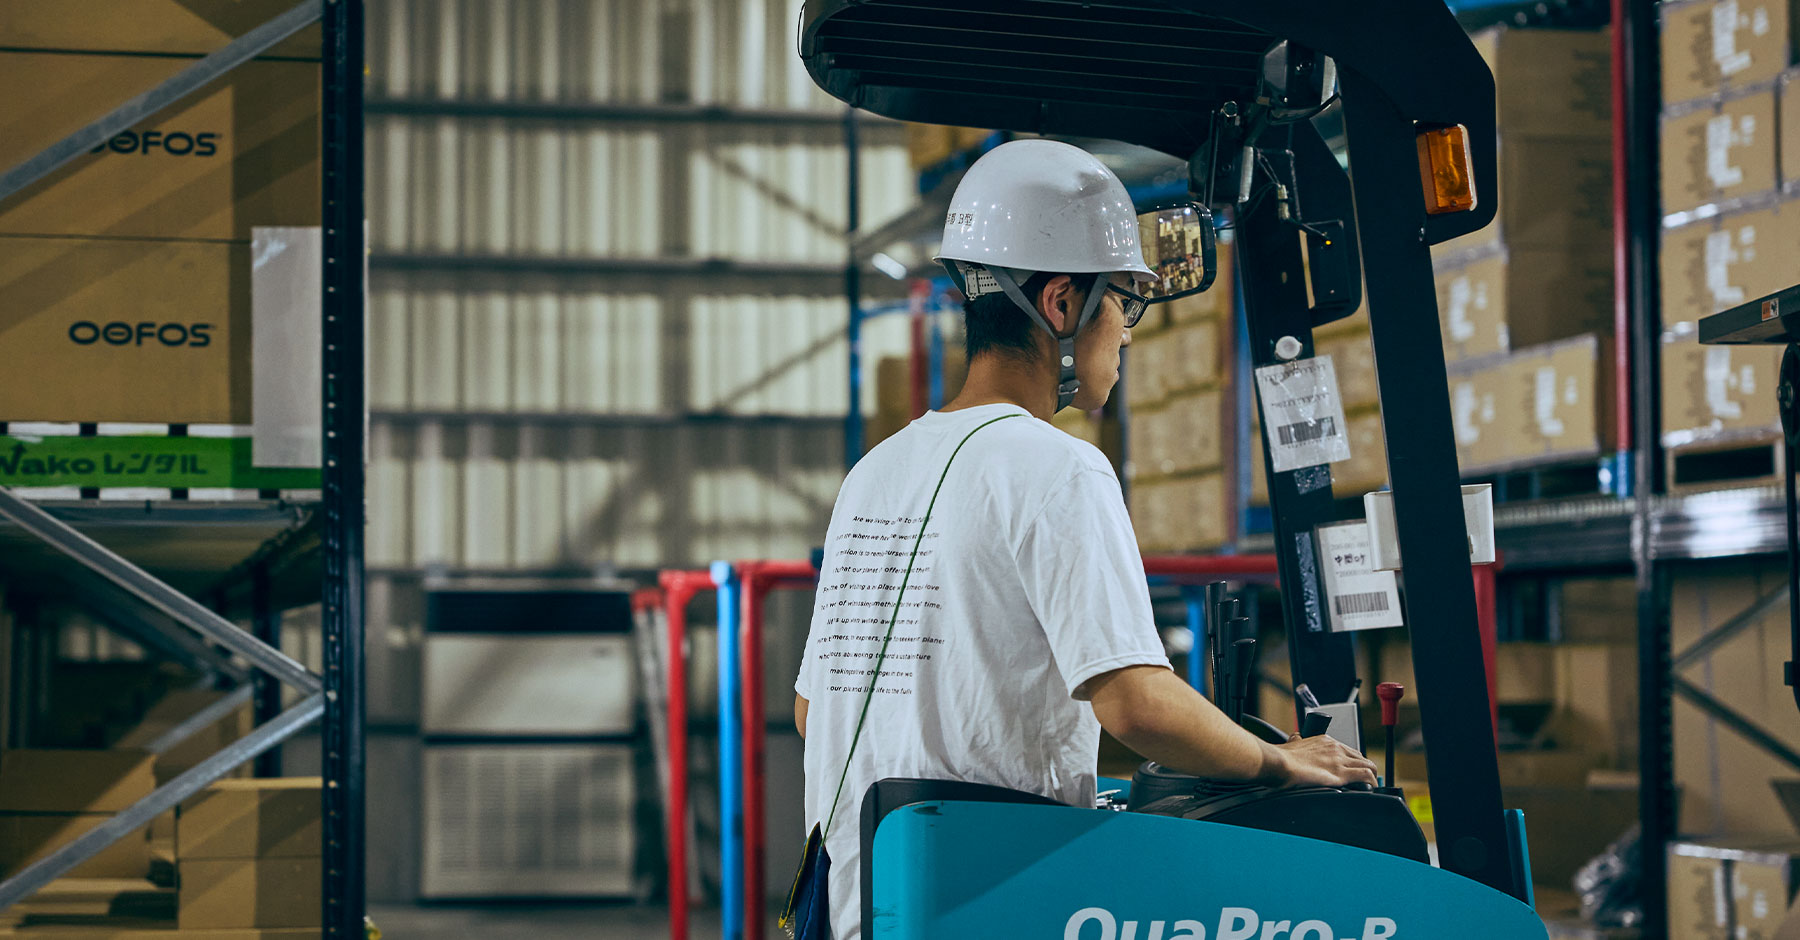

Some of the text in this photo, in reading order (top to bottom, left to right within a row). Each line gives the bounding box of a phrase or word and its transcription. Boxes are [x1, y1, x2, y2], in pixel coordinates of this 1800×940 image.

[88, 130, 217, 156] OFOS
[69, 321, 211, 347] OOFOS
[103, 453, 208, 475] レンタル
[838, 599, 847, 607] of
